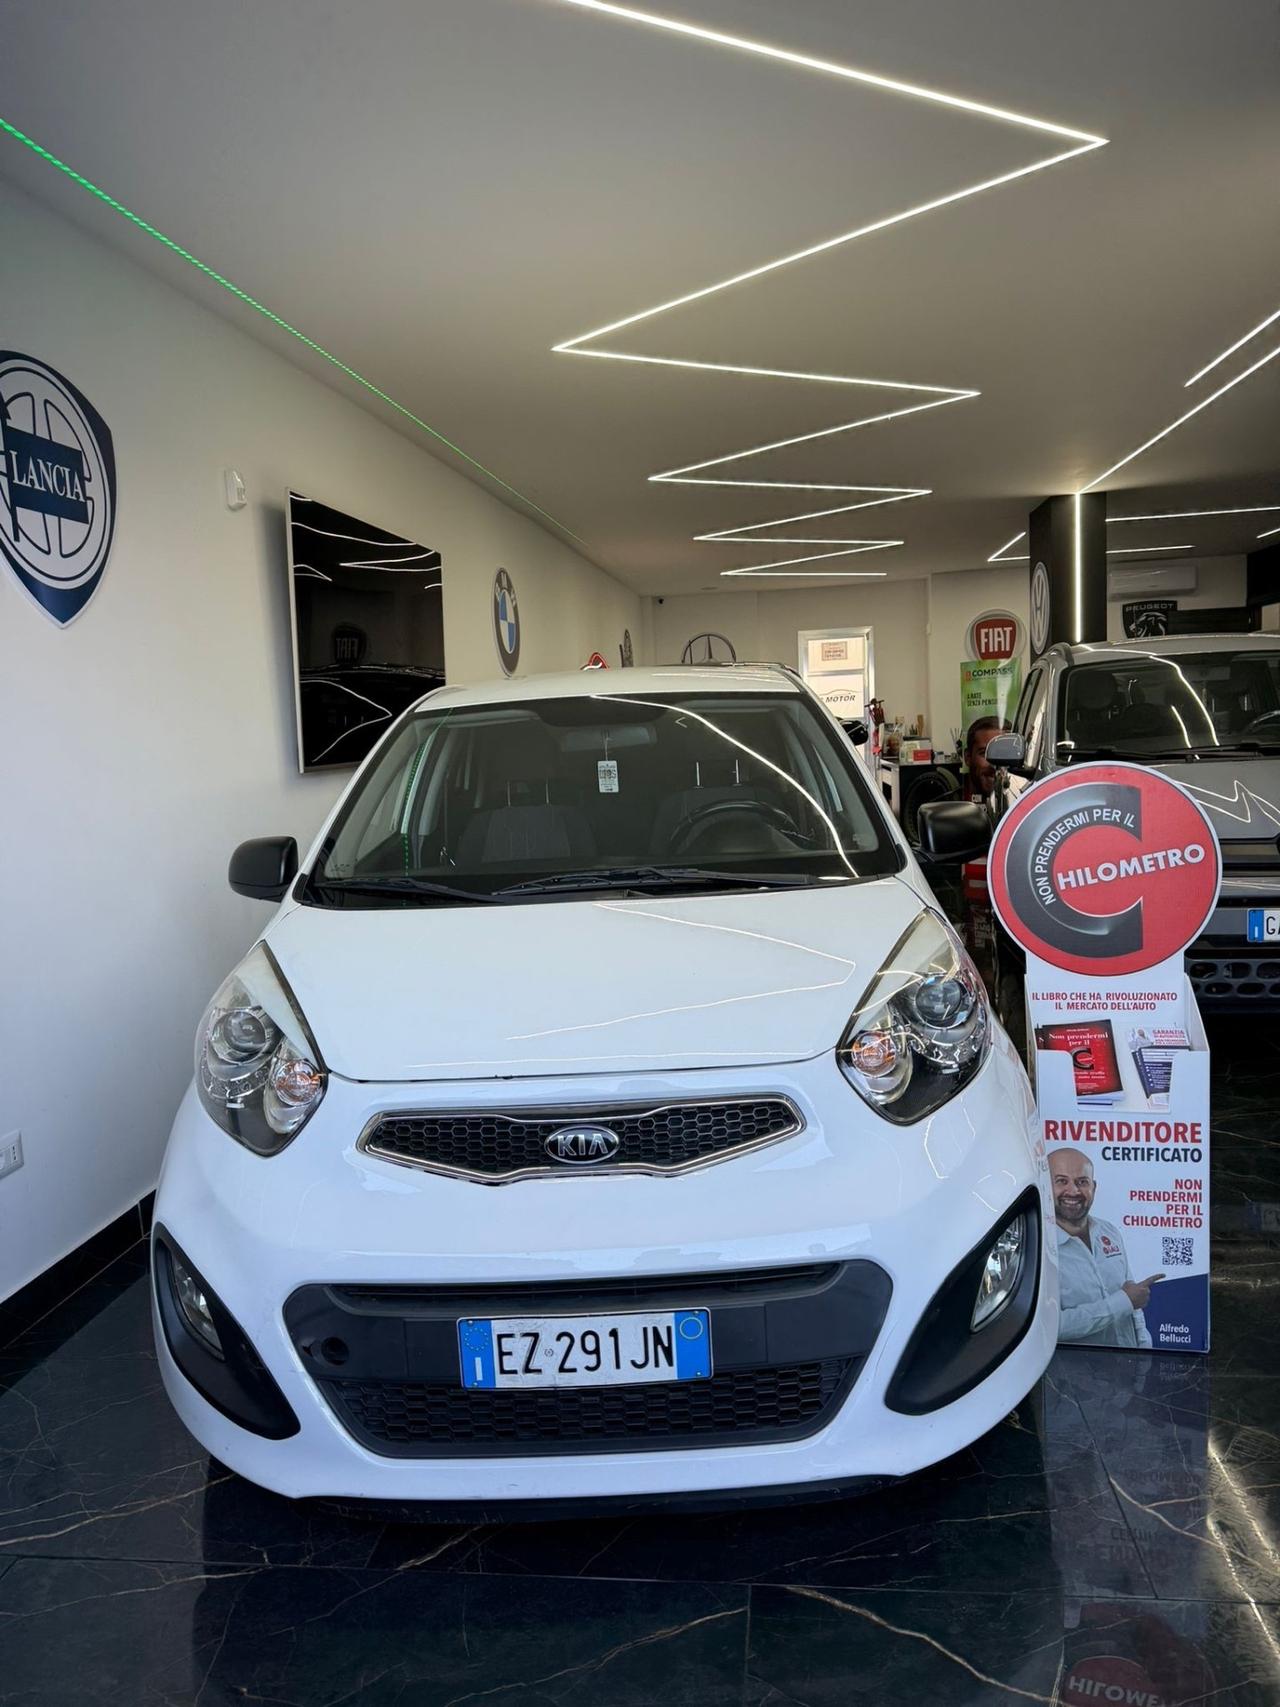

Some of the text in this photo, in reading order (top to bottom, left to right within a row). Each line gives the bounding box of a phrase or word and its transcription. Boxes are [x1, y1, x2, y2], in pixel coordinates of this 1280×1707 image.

[9, 449, 86, 503] LANCIA
[1125, 603, 1175, 612] PEUGEOT
[980, 626, 1013, 653] FIAT
[825, 694, 856, 704] MOTOR
[1035, 808, 1135, 905] NON PRENDERMI PER IL
[1266, 915, 1280, 935] G
[1032, 991, 1178, 1001] IL LIBRO CHE HA RIVOLUZIONATO
[1055, 1001, 1157, 1011] IL MERCATO DELL'AUTO
[1044, 1119, 1203, 1144] RIVENDITORE
[557, 1133, 609, 1157] KIA
[1101, 1146, 1203, 1163] CERTIFICATO
[1174, 1178, 1203, 1191] NON
[1129, 1190, 1203, 1204] PRENDERMI
[1166, 1203, 1204, 1217] PER IL
[1122, 1215, 1203, 1229] CHILOMETRO
[1159, 1322, 1190, 1334] Alfredo
[1159, 1333, 1192, 1344] Bellucci
